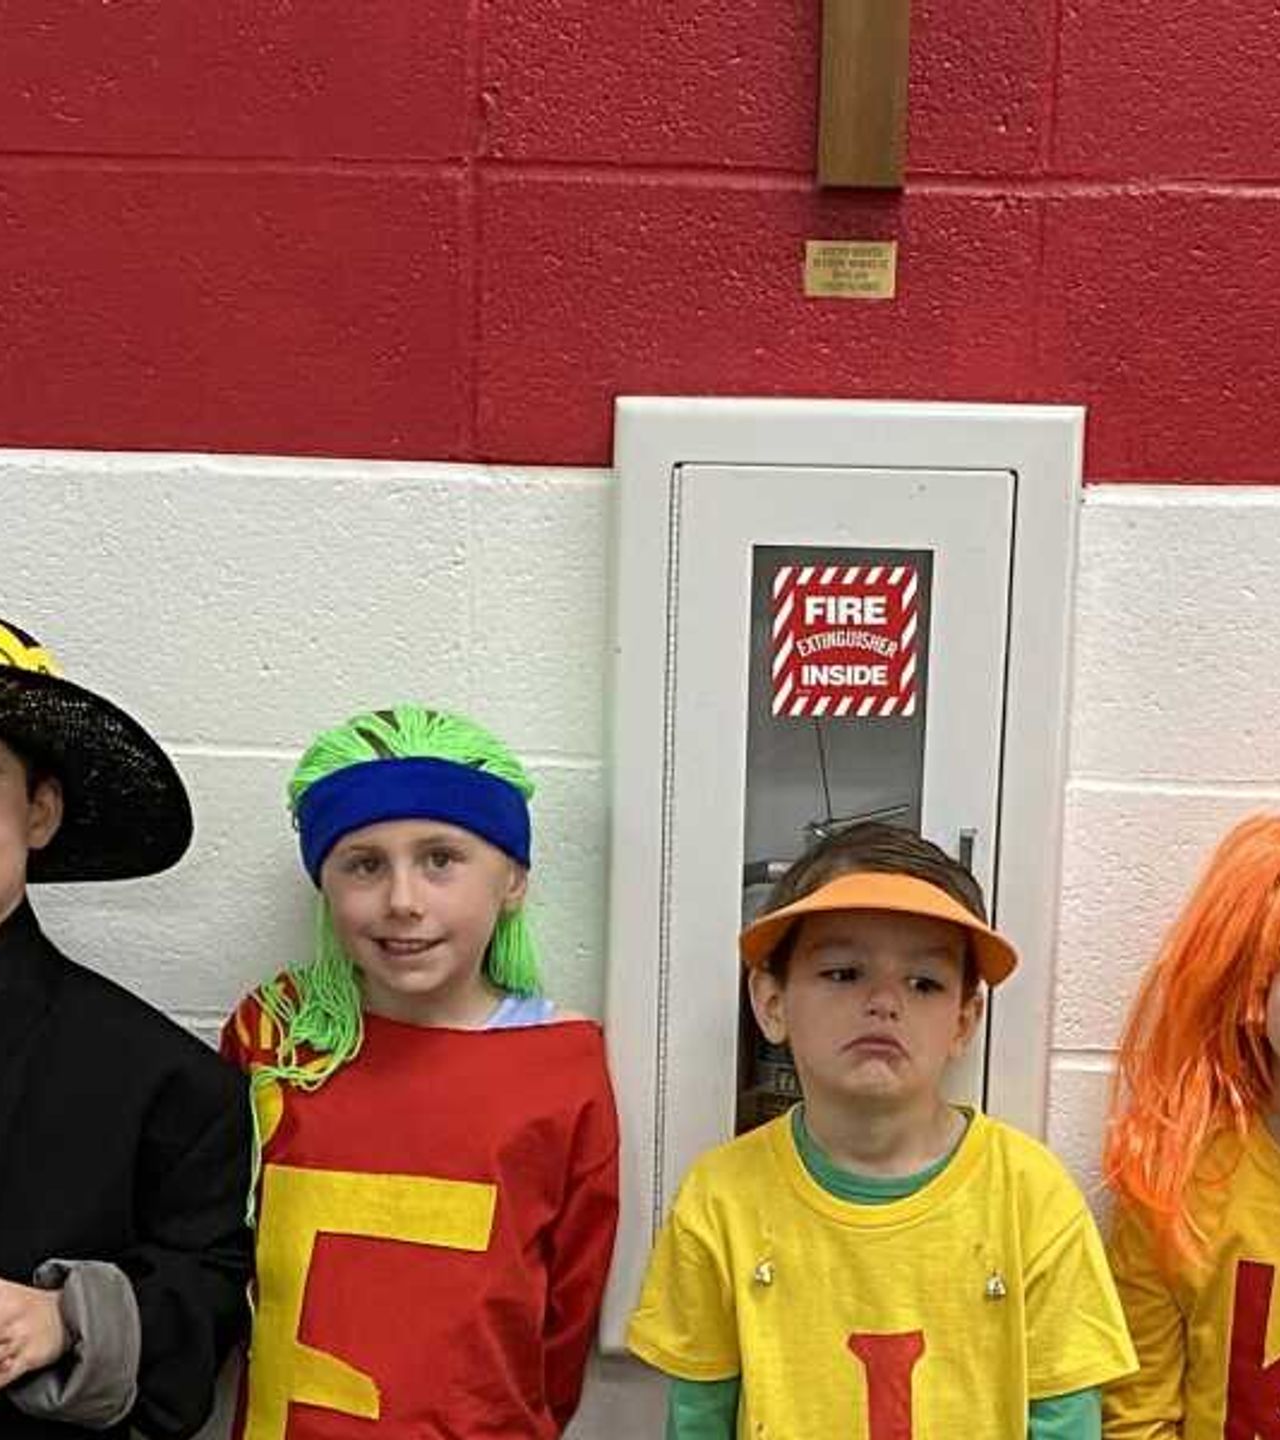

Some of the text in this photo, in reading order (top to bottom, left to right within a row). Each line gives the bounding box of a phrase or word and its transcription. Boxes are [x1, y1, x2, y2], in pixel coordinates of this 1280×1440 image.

[804, 595, 888, 625] FIRE
[795, 628, 899, 658] EXTINGUISHER
[800, 664, 889, 687] INSIDE
